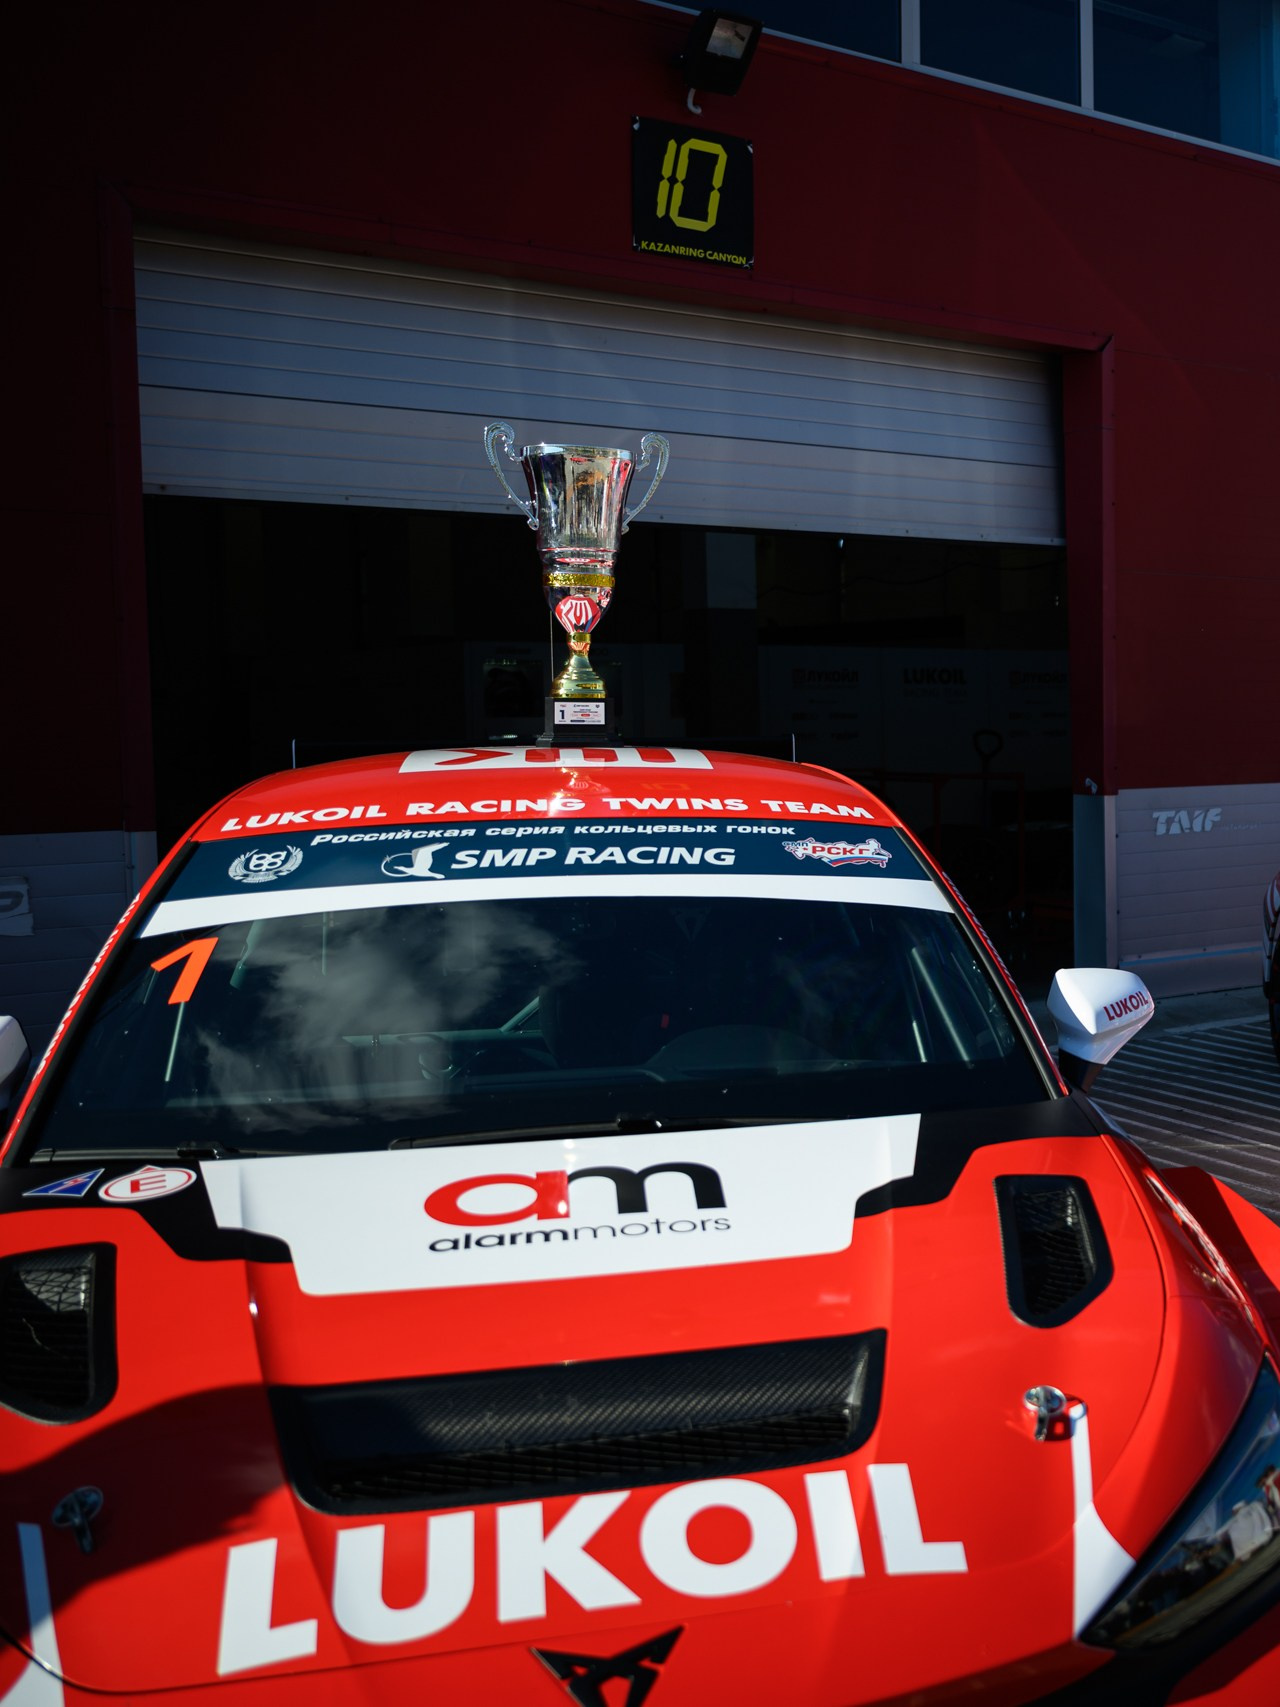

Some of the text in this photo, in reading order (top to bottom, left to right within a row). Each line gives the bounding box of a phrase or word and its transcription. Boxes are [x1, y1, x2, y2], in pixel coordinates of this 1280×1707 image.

[656, 138, 728, 232] 10
[641, 240, 747, 266] KAZANRING CANYON
[559, 709, 565, 720] 1
[220, 797, 875, 832] LUKOIL RACING TWINS TEAM
[310, 823, 797, 846] Российская серия кольцевых гонок
[811, 844, 871, 857] РСКГ
[450, 846, 737, 870] SMP RACING
[151, 937, 219, 1005] 1
[1103, 990, 1149, 1022] LUKOIL
[423, 1160, 727, 1228] am
[428, 1215, 732, 1253] alarmmotors
[216, 1462, 969, 1677] LUKOIL
